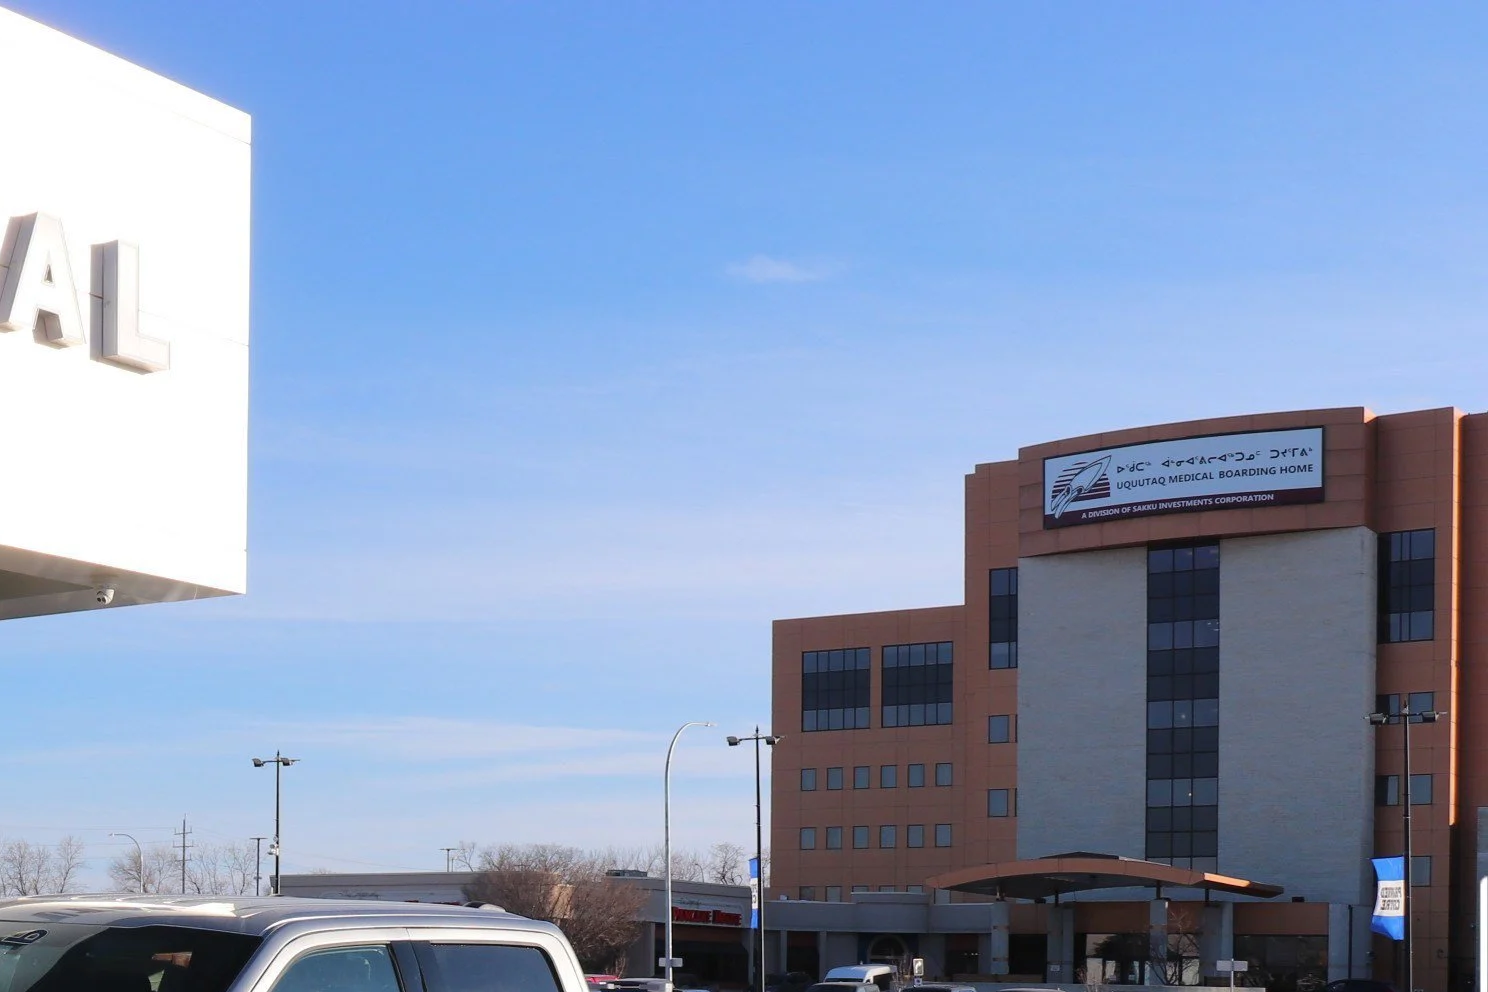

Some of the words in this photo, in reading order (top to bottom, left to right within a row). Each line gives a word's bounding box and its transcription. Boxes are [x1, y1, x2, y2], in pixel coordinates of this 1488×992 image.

[1116, 476, 1166, 490] UQUUTAQ
[1168, 472, 1214, 485] MEDICAL
[1218, 464, 1277, 479] BOARDING
[1280, 463, 1314, 474] HOME
[1088, 508, 1120, 518] DIVISION
[1121, 506, 1131, 514] OF
[1132, 503, 1158, 512] SAKKU
[1159, 498, 1214, 510] INVESTMENTS
[1214, 494, 1275, 504] CORPORATION
